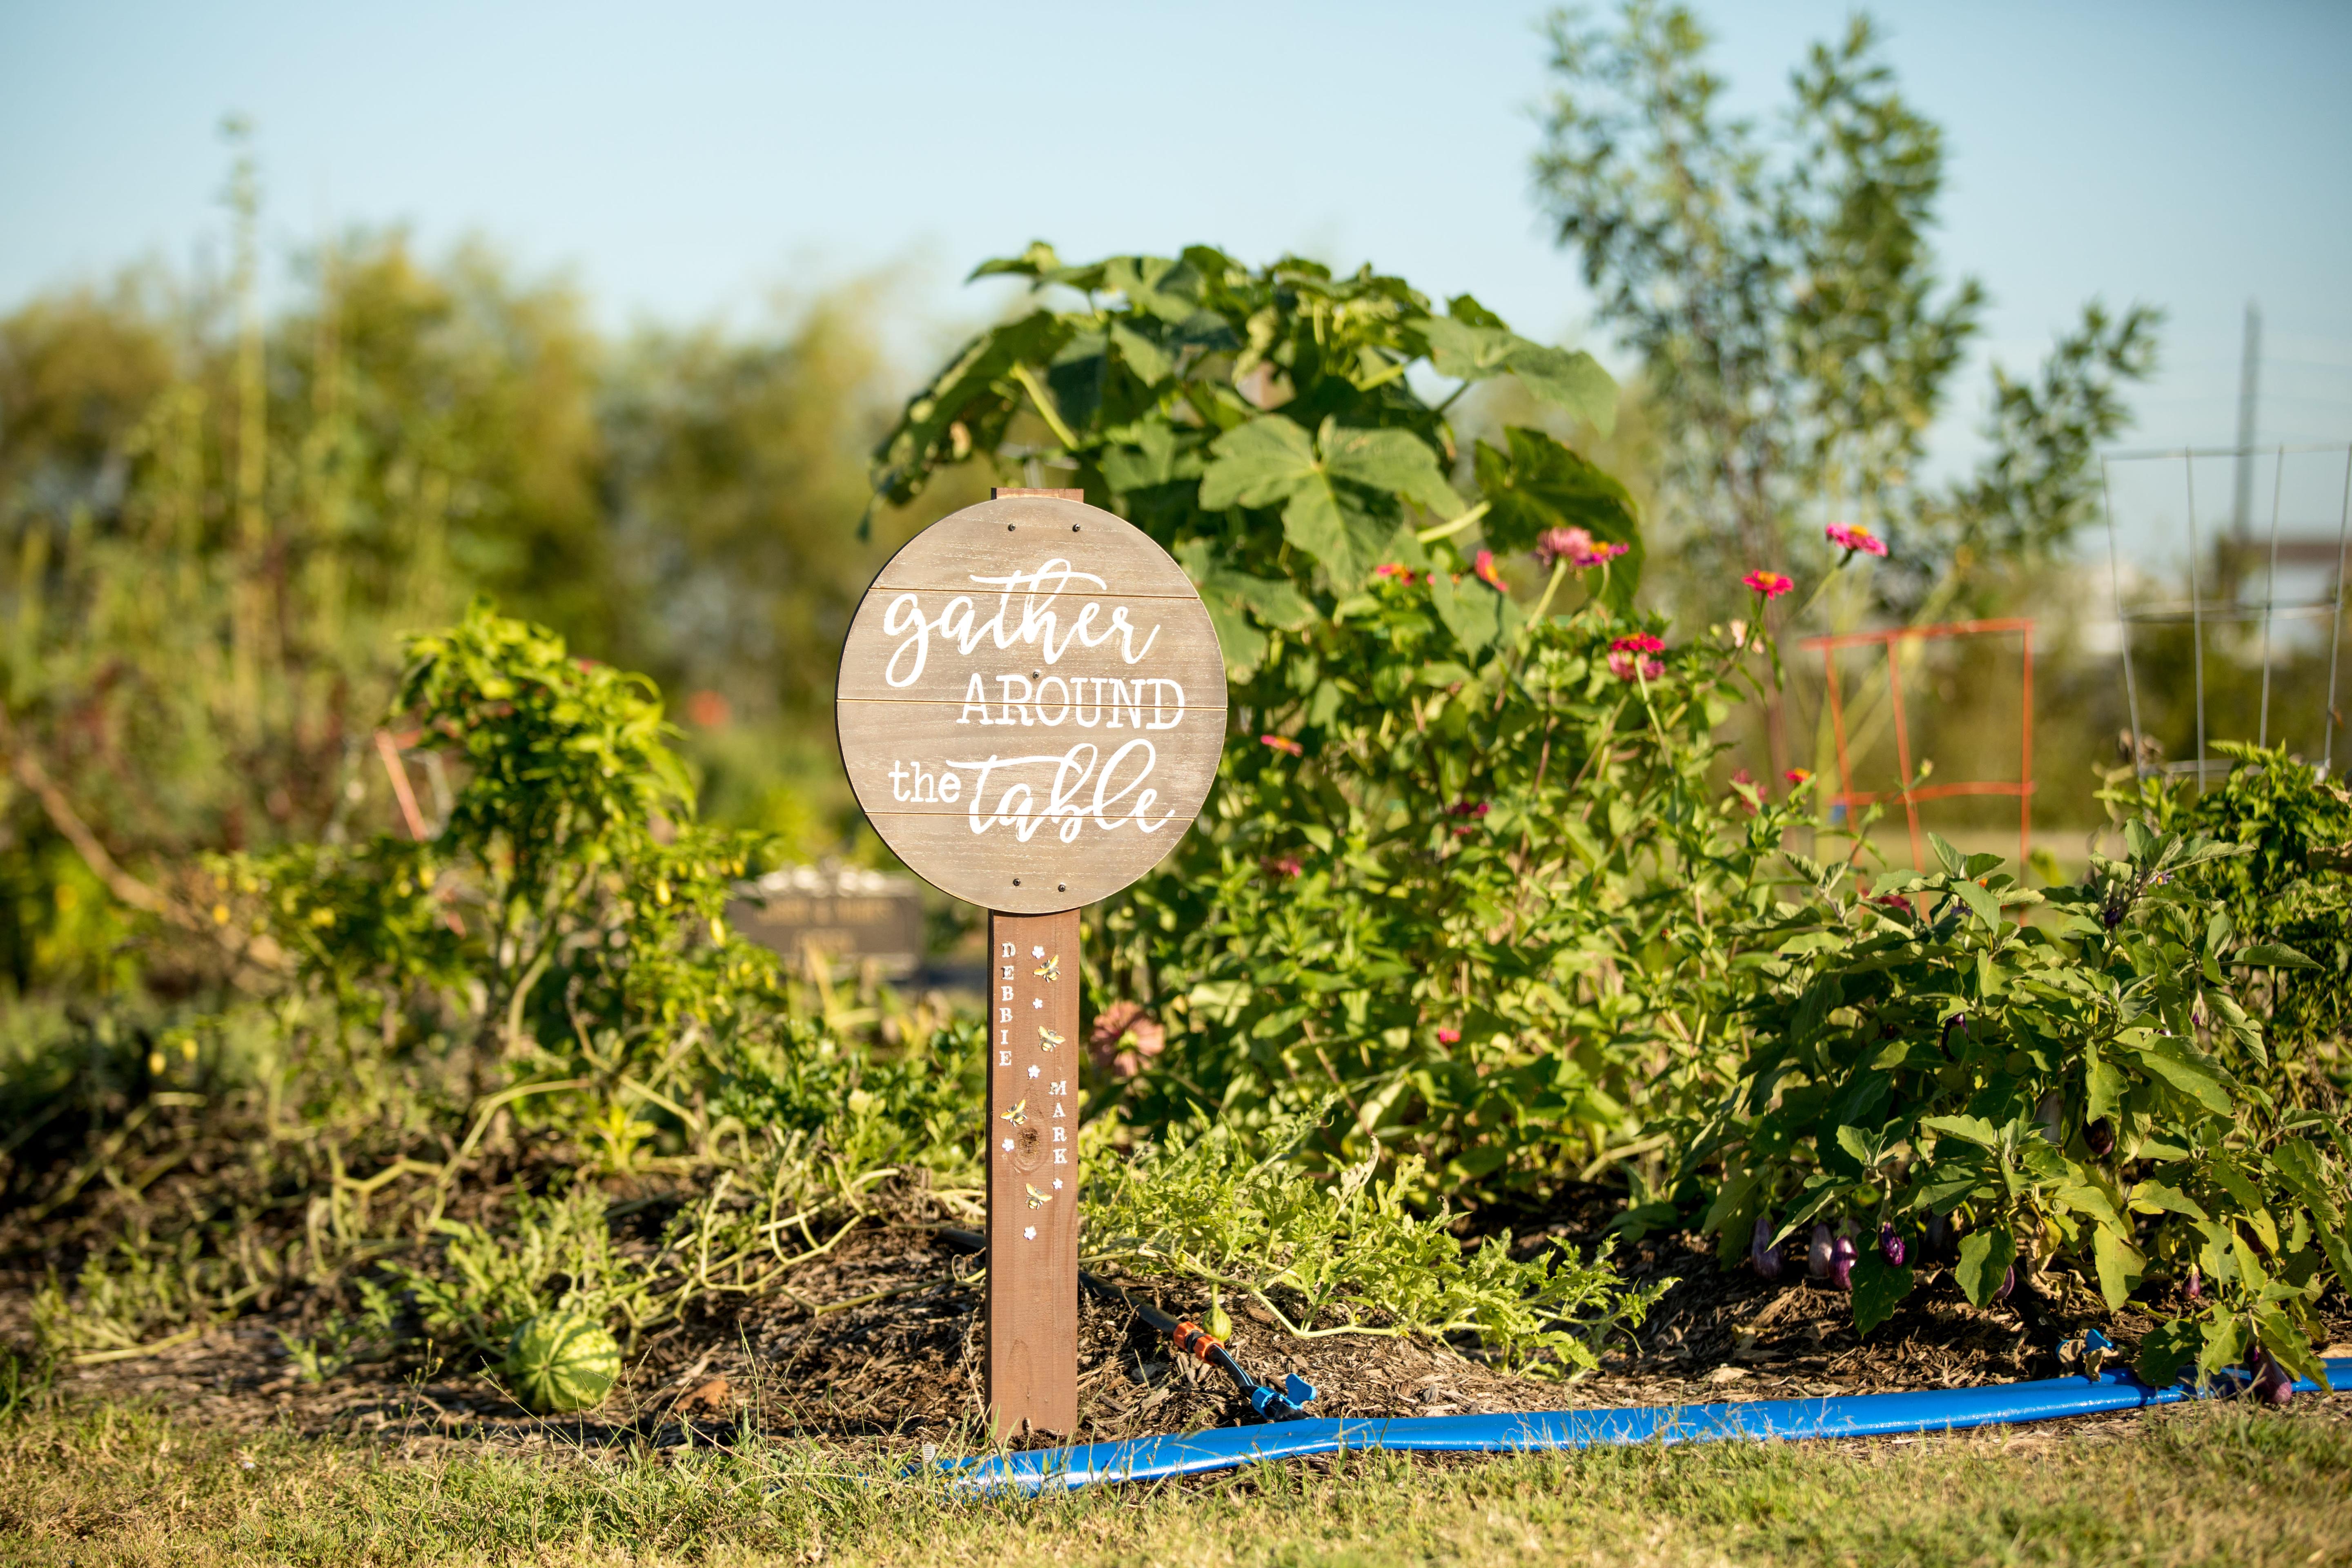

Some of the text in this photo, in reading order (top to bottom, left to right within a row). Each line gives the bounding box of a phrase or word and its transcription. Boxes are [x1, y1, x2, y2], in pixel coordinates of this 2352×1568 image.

[883, 558, 1160, 687] gather
[956, 673, 1185, 729] AROUND
[888, 738, 1175, 843] the table
[999, 942, 1016, 1066] DEBBIE
[1048, 1080, 1067, 1165] MARK
